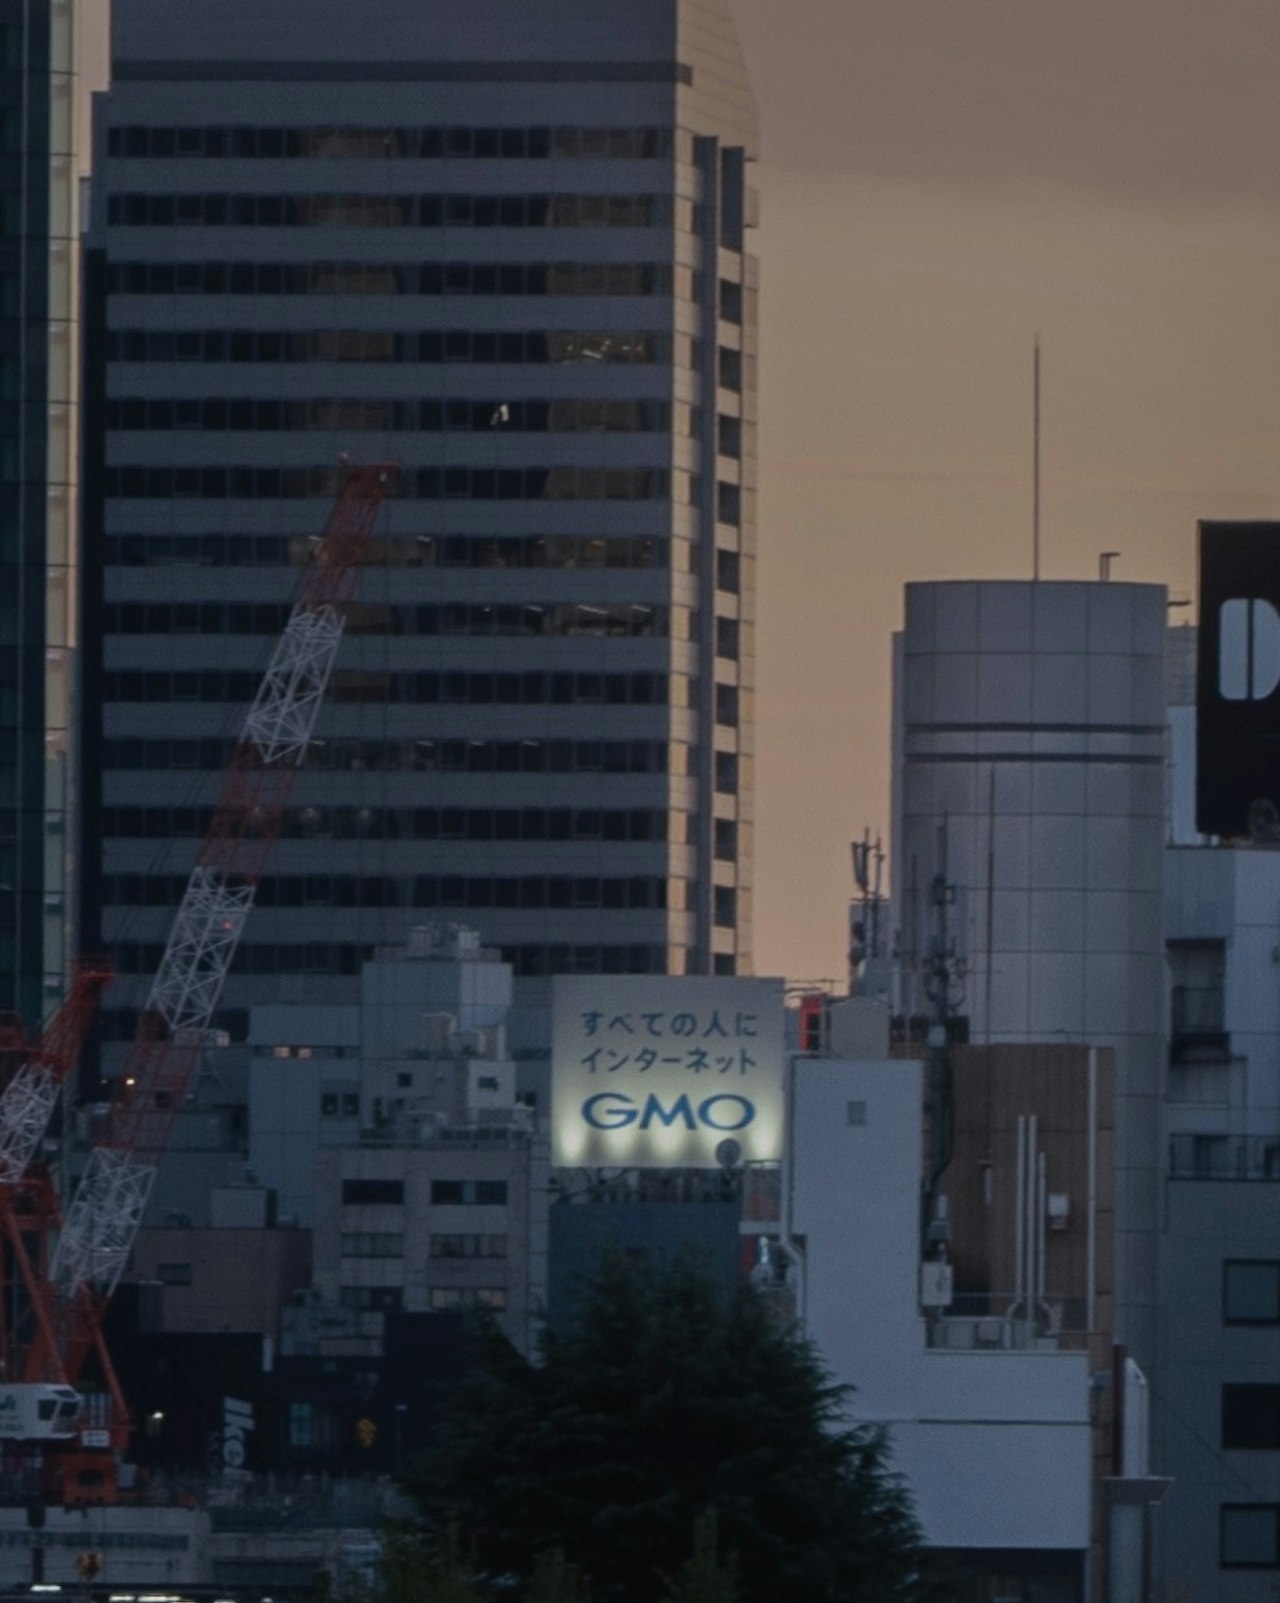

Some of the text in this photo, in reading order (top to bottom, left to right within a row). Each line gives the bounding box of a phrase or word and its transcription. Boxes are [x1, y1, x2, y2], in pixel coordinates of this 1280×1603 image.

[580, 1009, 758, 1038] すべての人に
[580, 1046, 757, 1074] インターネット
[581, 1091, 756, 1131] GMO
